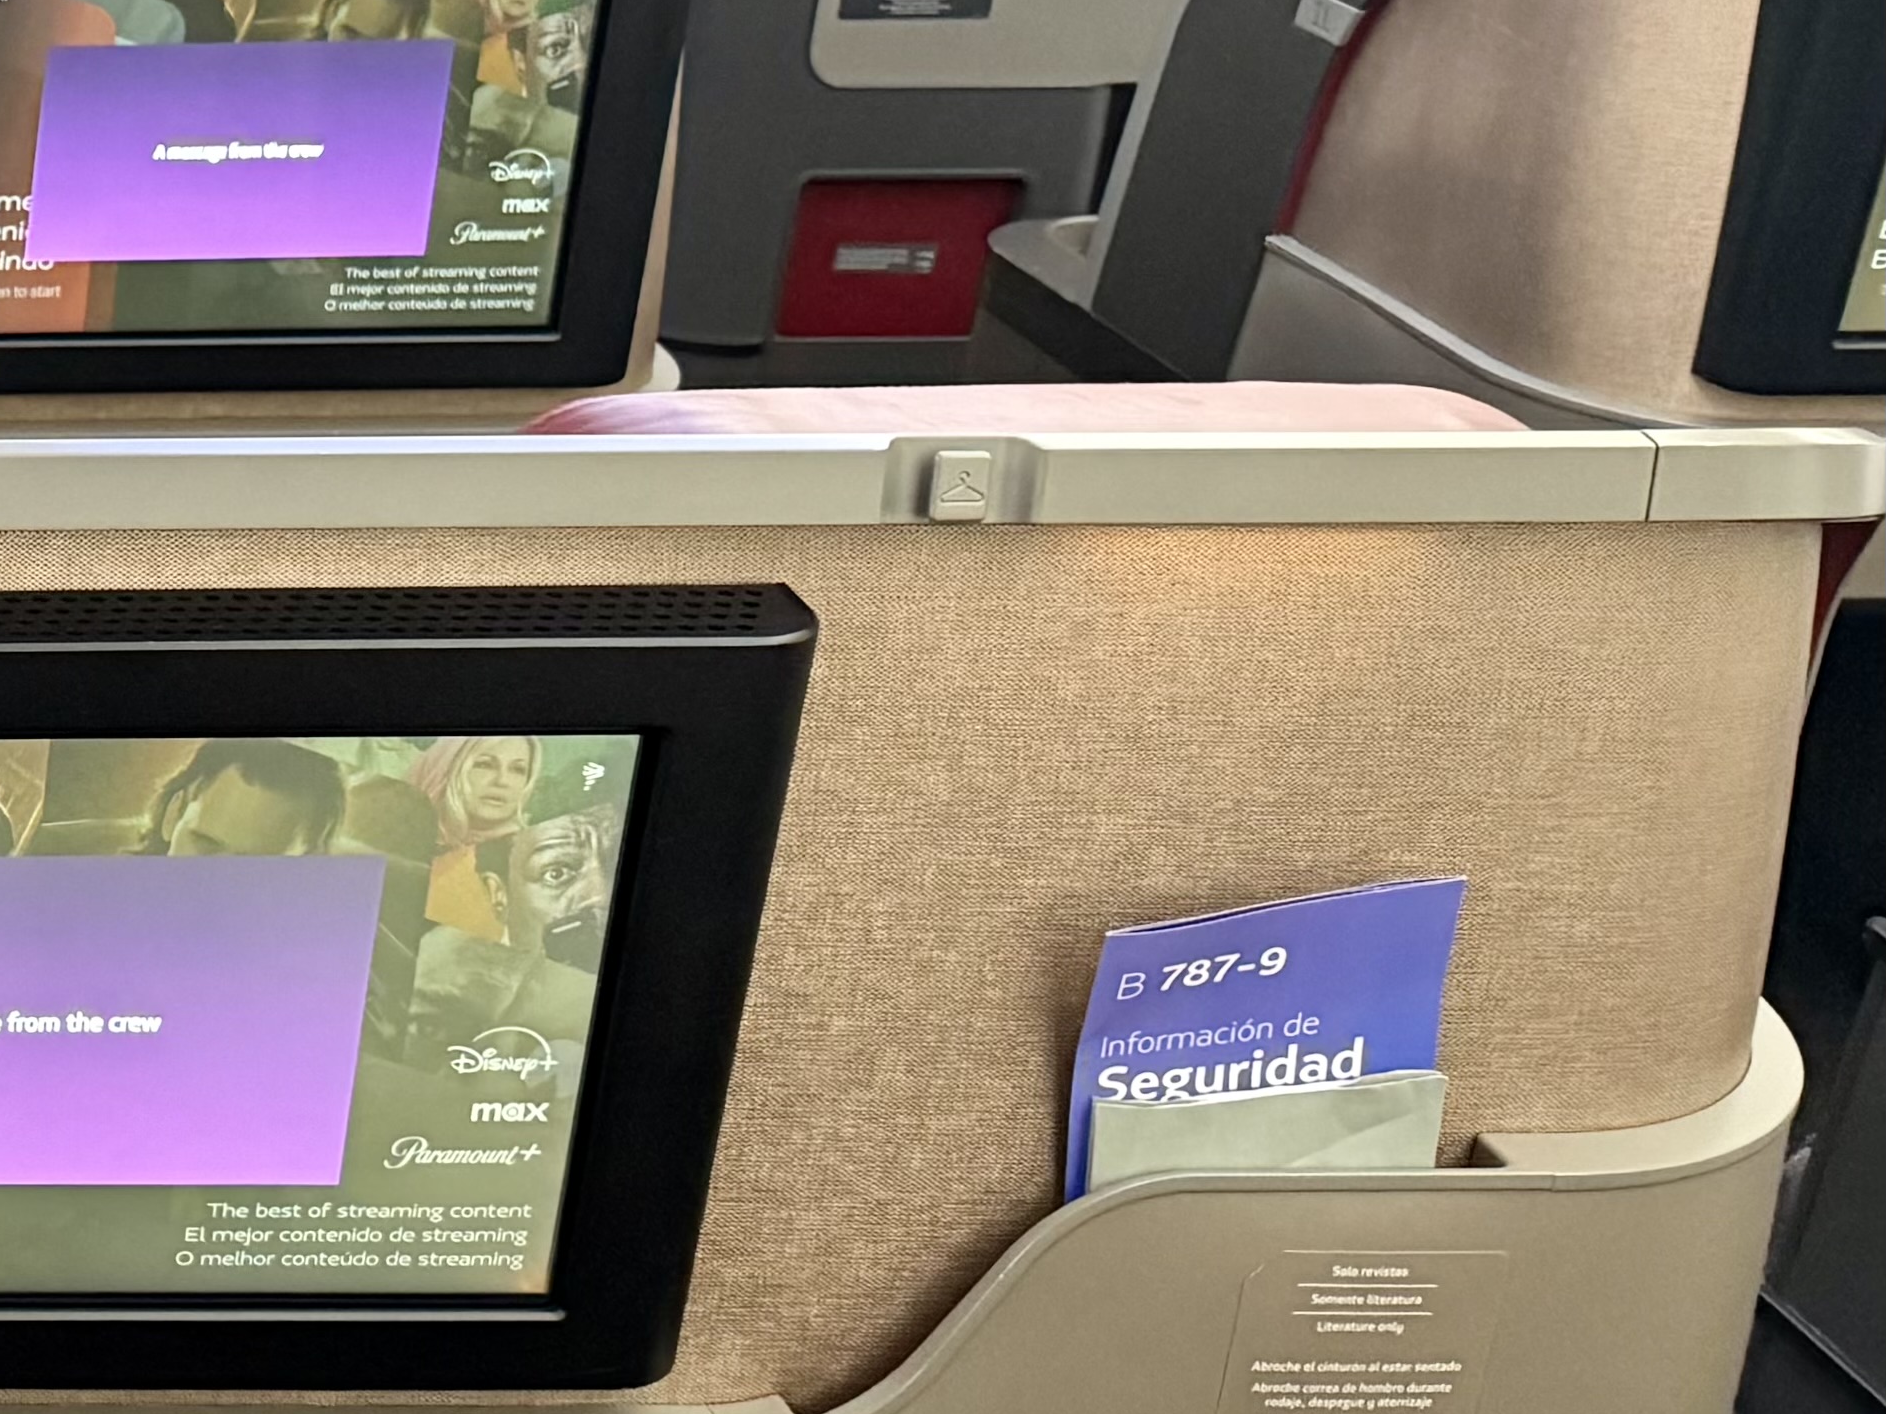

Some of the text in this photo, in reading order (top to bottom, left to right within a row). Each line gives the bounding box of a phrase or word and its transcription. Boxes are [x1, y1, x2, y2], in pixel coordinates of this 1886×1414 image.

[502, 198, 550, 213] max
[1116, 946, 1287, 1000] B 787-9
[6, 1010, 61, 1033] from
[65, 1010, 104, 1033] the
[107, 1016, 162, 1032] crew
[1100, 1011, 1320, 1059] Información de
[1098, 1036, 1364, 1103] Seguridad
[470, 1102, 549, 1122] max
[383, 1136, 541, 1169] Paramount+
[207, 1202, 532, 1223] The best of streaming content
[184, 1226, 528, 1246] El mejor contenido de streaming
[175, 1251, 524, 1271] O melhor conteúdo de streaming
